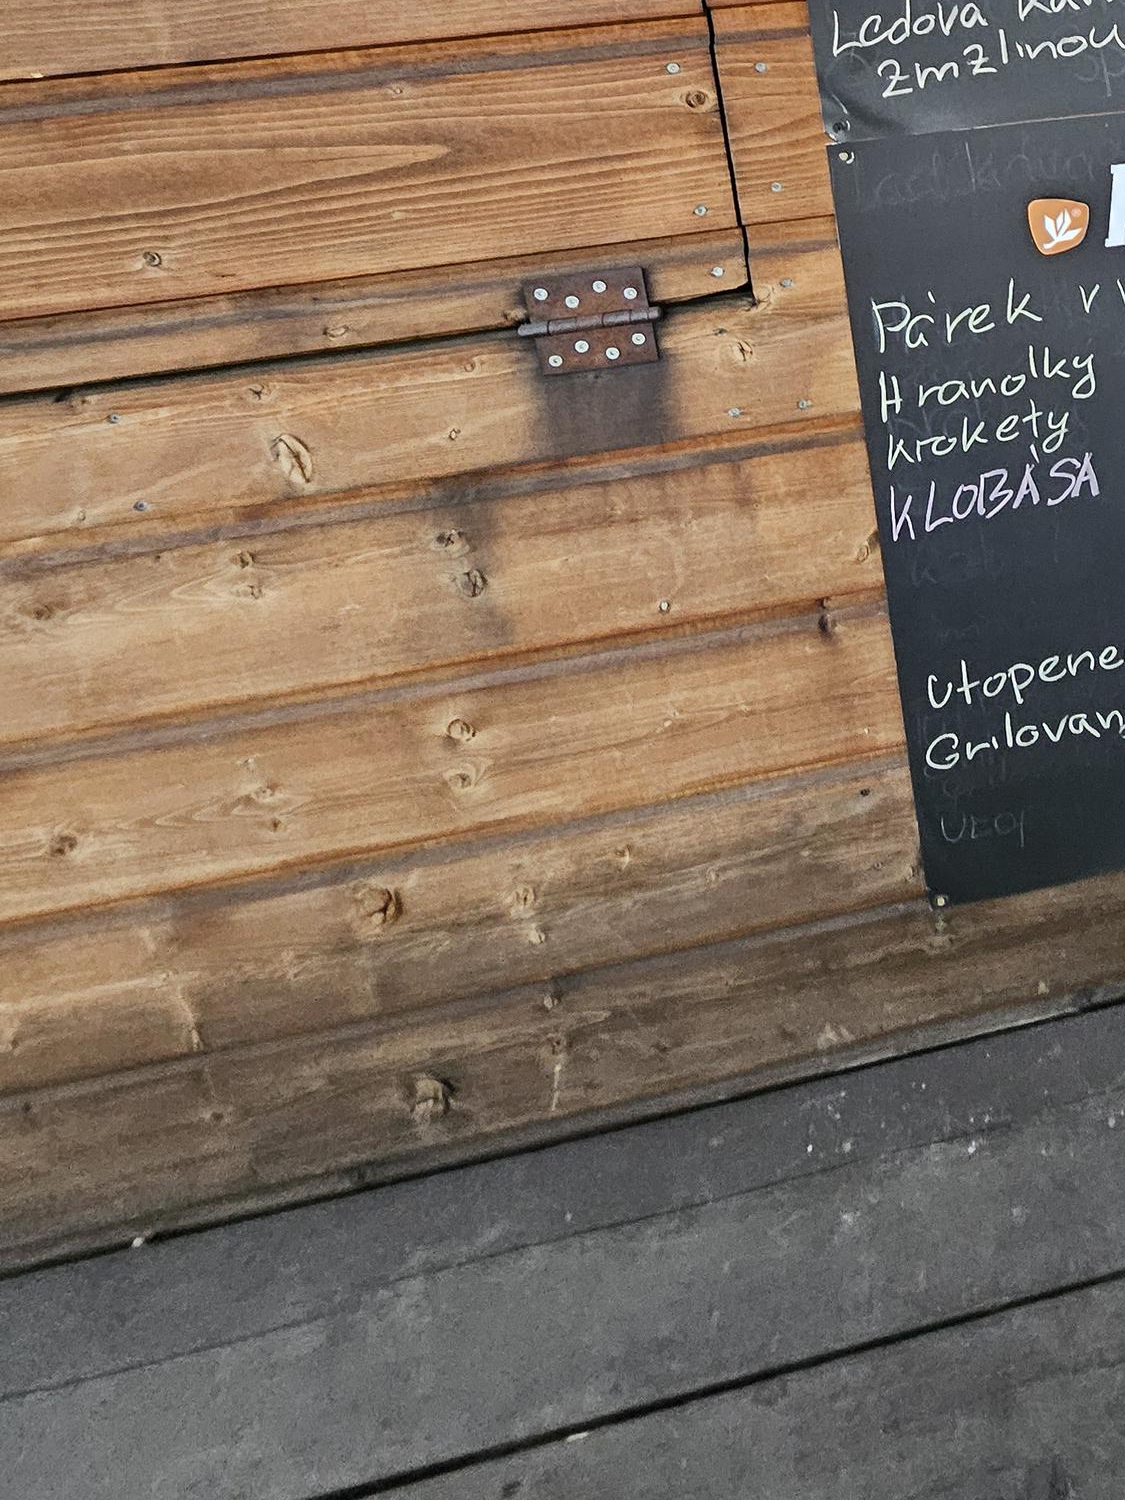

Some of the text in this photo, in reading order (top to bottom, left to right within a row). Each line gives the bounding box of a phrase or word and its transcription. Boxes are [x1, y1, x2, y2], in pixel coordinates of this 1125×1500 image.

[869, 275, 1044, 355] Párek
[878, 344, 1098, 424] Hranolky
[889, 443, 1101, 544] KLOBÁSA
